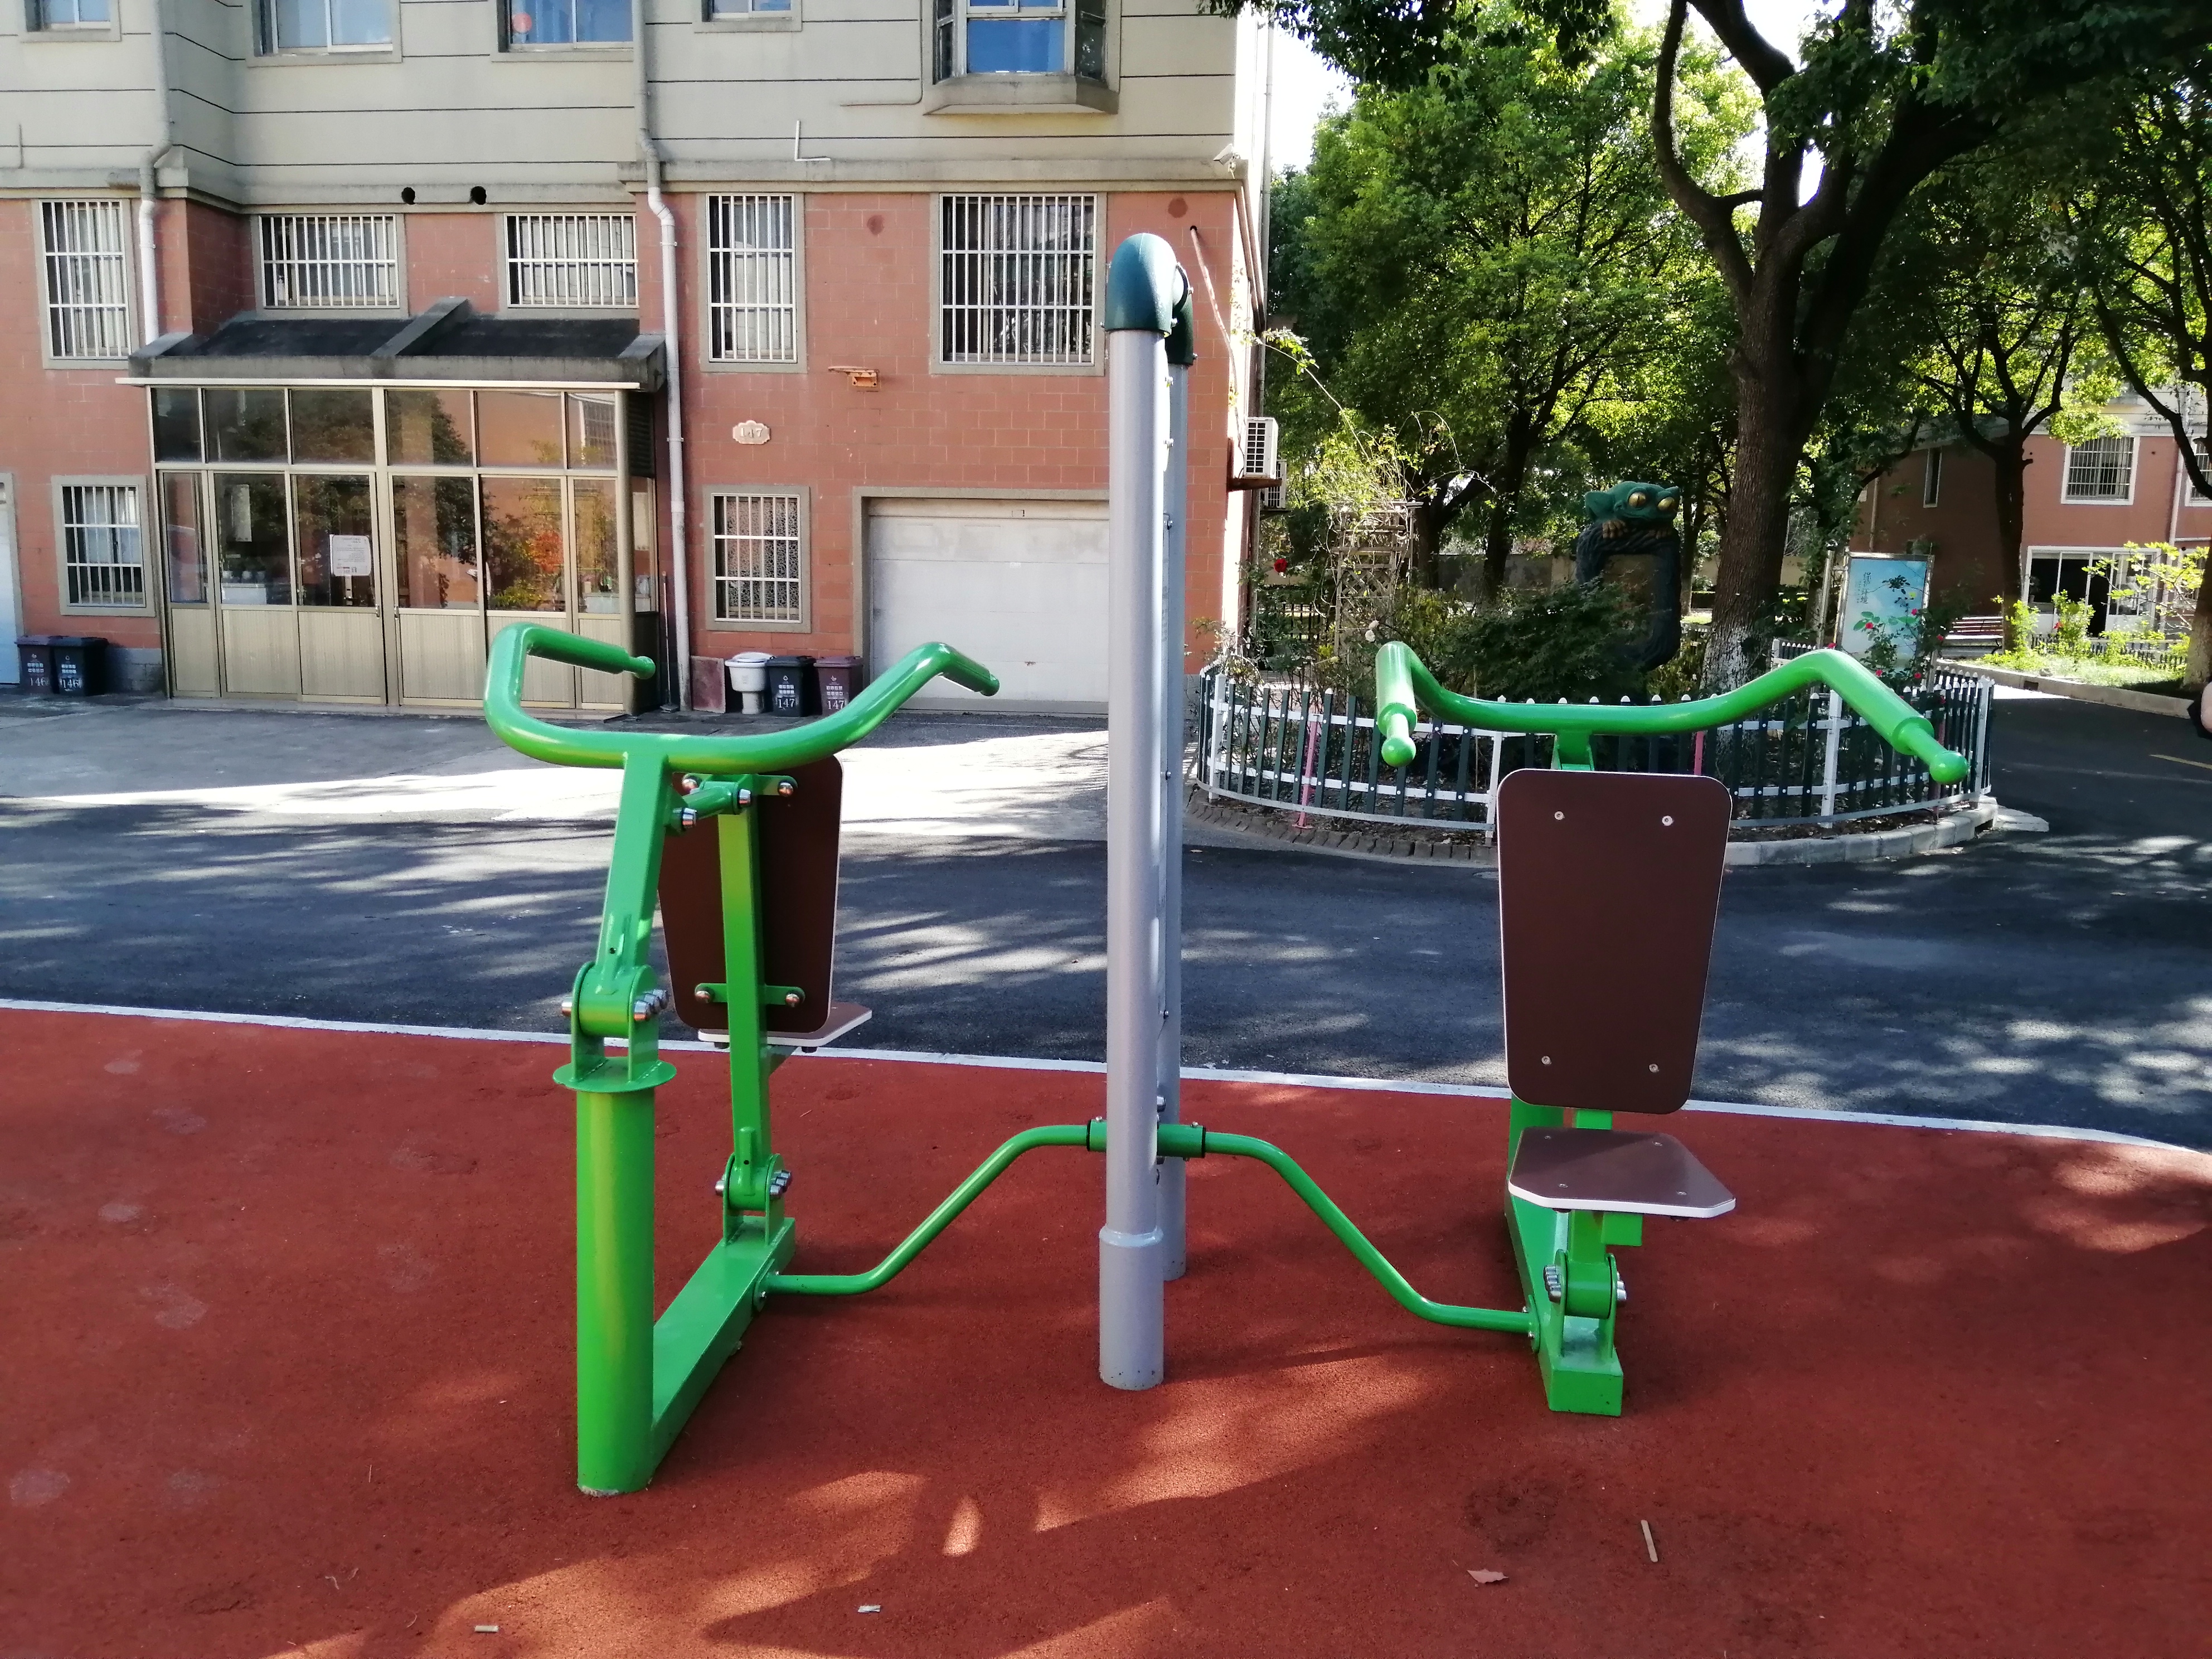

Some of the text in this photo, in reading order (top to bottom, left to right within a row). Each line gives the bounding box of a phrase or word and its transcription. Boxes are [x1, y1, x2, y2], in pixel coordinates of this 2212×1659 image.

[740, 427, 763, 438] 147
[62, 678, 79, 688] 146
[778, 698, 795, 708] 147
[827, 700, 845, 710] 147
